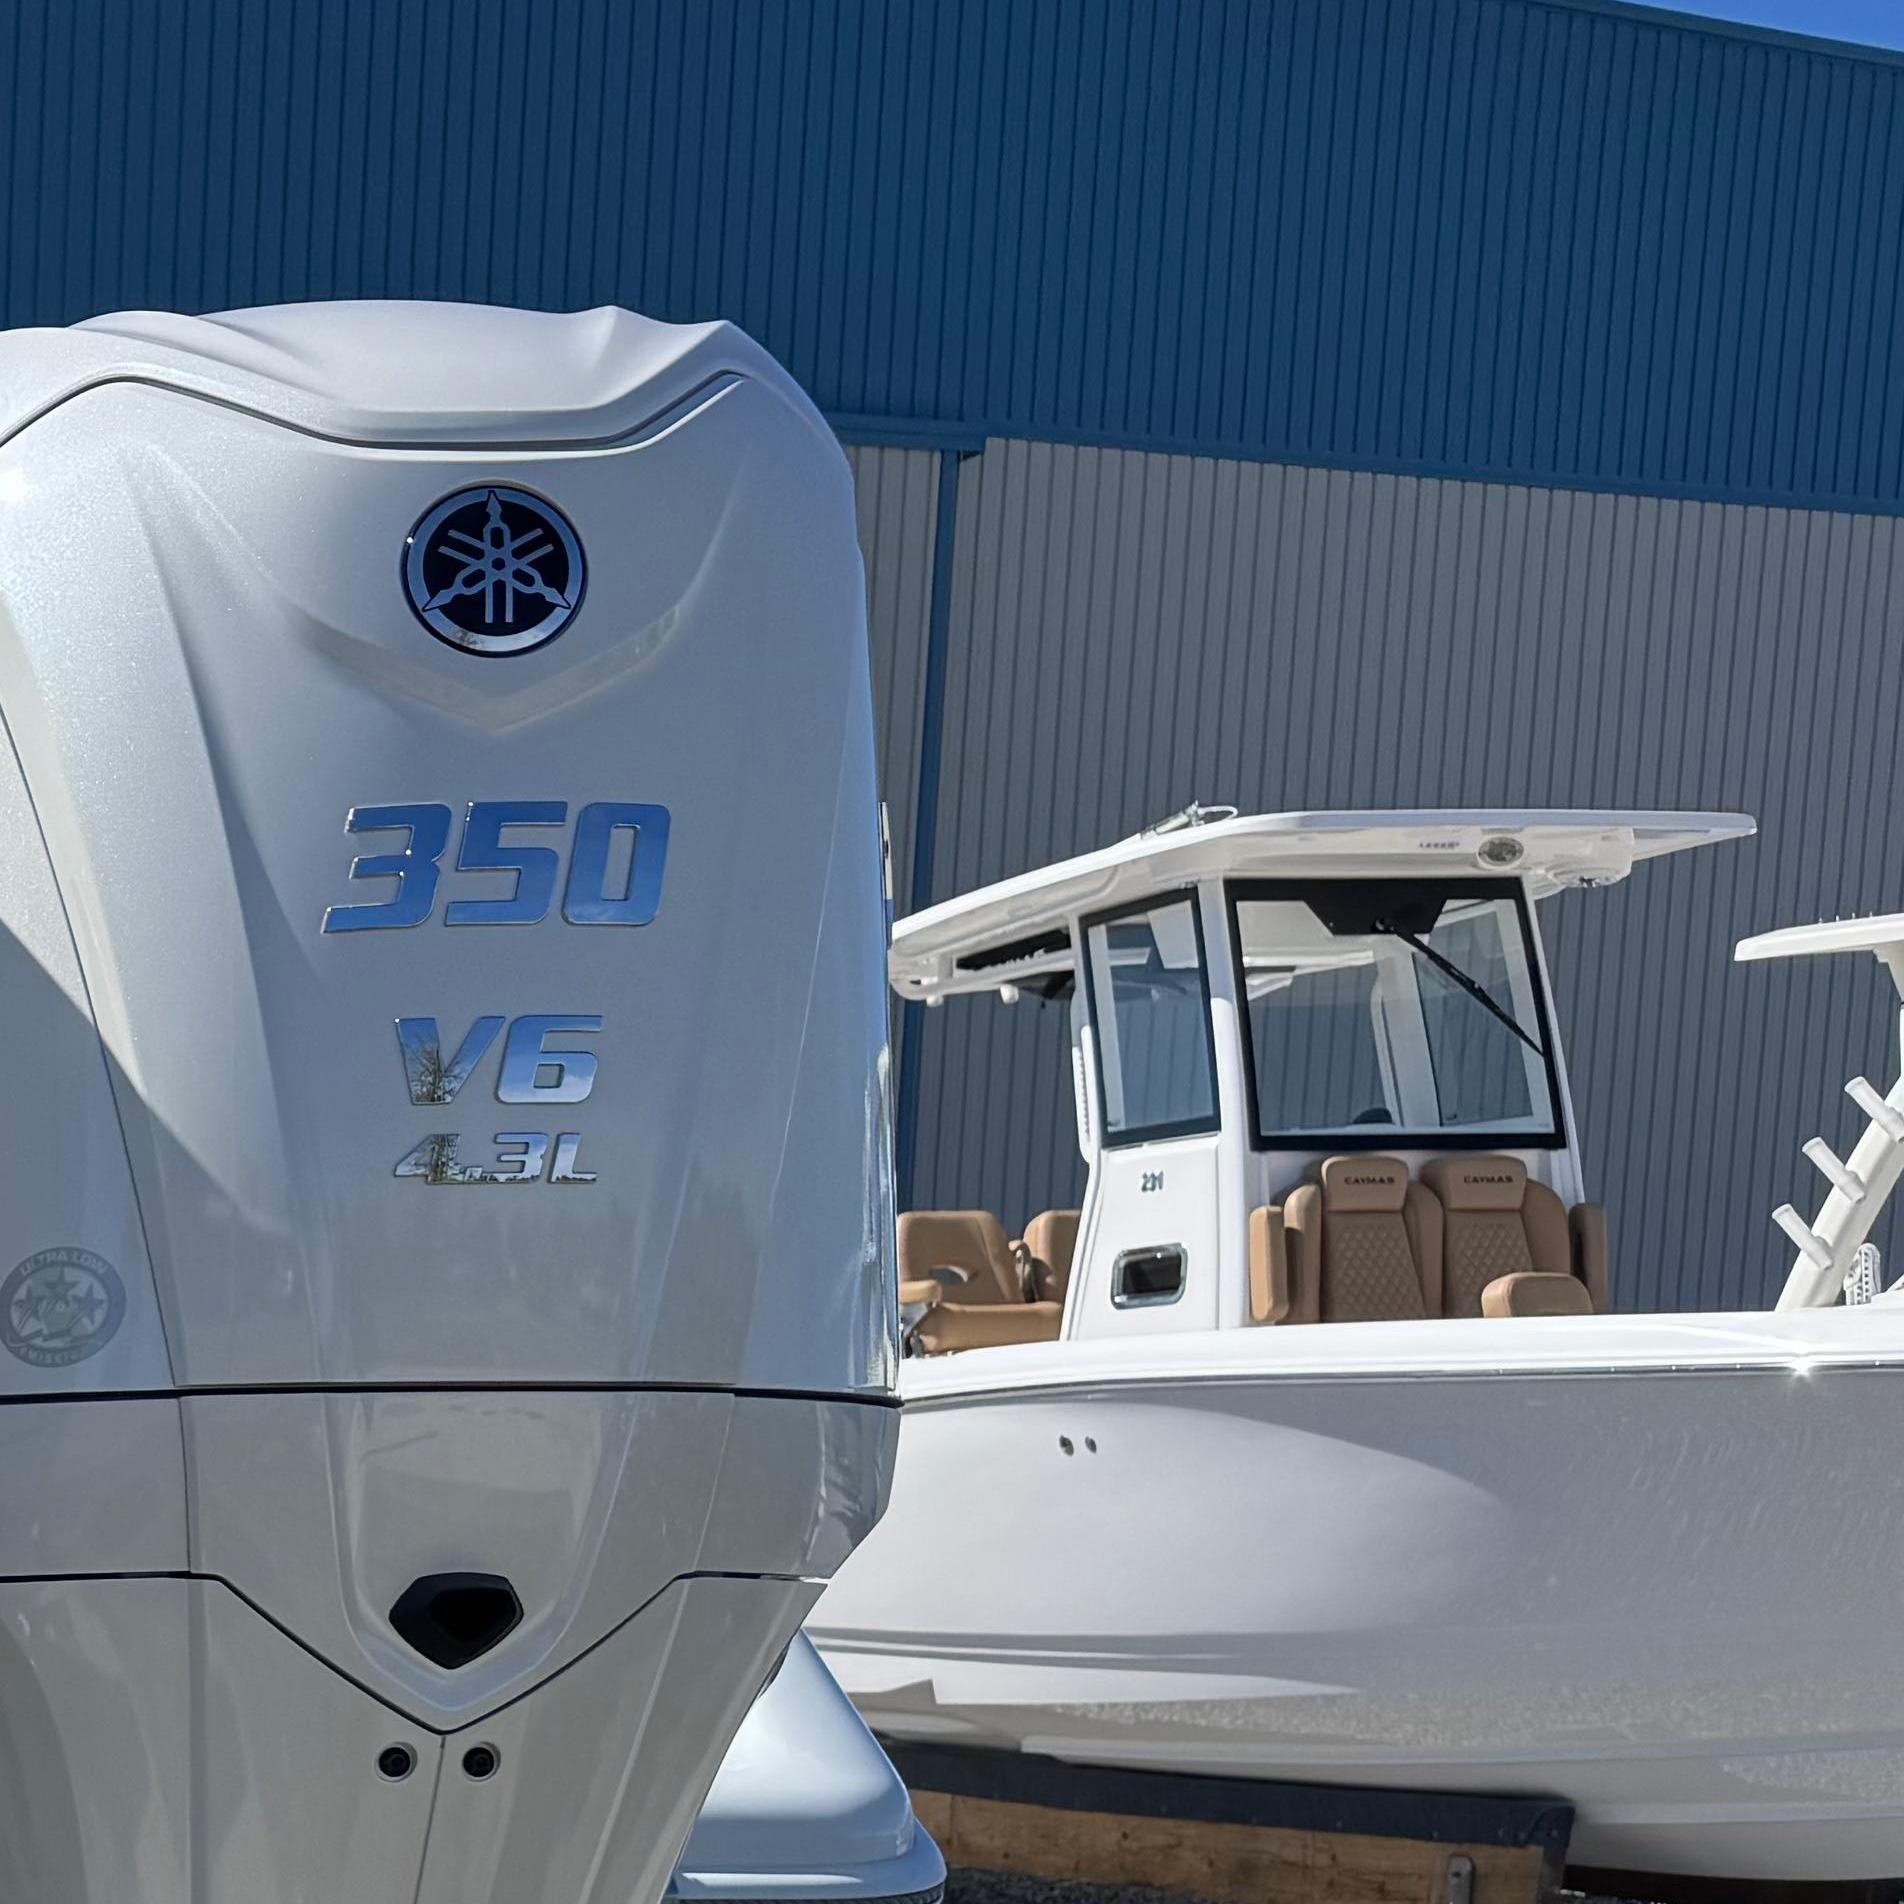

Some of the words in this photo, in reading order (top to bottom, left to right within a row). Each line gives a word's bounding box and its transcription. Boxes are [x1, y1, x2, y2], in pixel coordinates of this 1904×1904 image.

[320, 800, 672, 934] 350
[394, 1014, 604, 1106] V6
[393, 1132, 598, 1185] 4.3L
